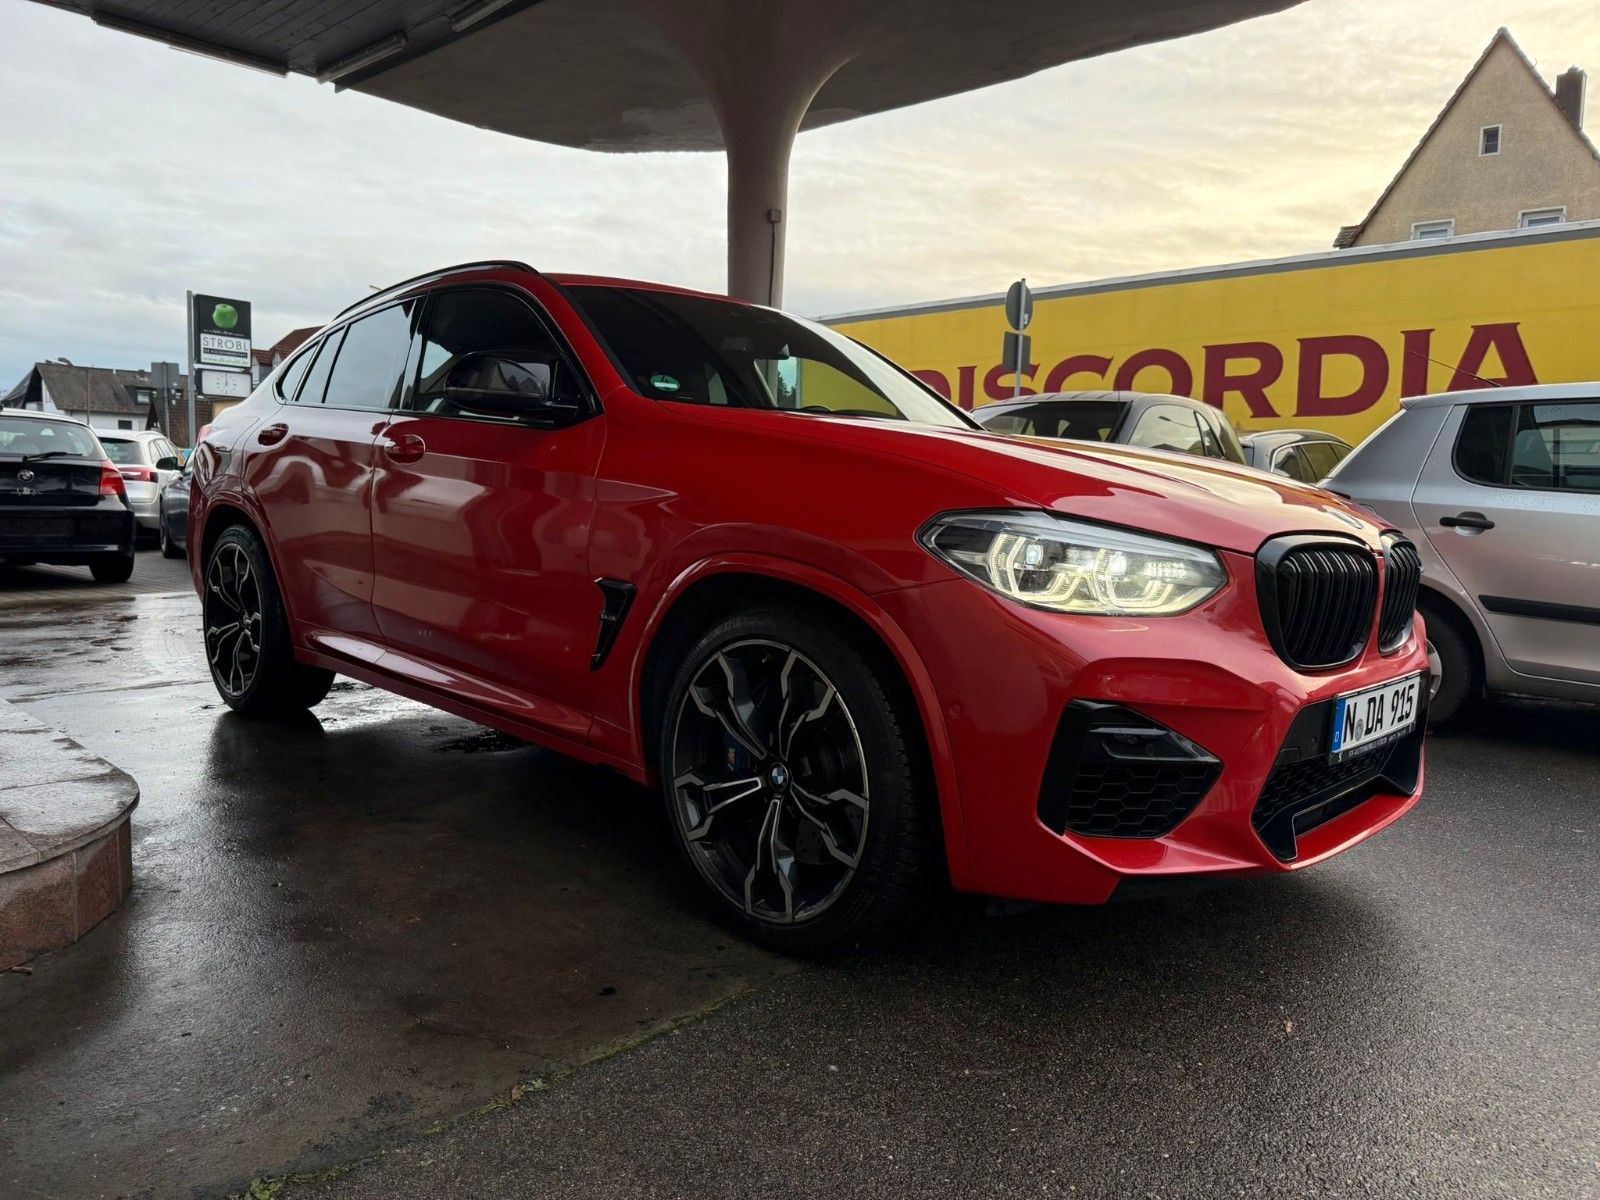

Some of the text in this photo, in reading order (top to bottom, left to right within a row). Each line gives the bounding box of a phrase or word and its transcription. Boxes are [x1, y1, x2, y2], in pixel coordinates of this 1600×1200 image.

[202, 336, 249, 351] STROBL
[1342, 701, 1358, 744] N
[1364, 693, 1385, 736] DA
[1390, 683, 1415, 726] 915
